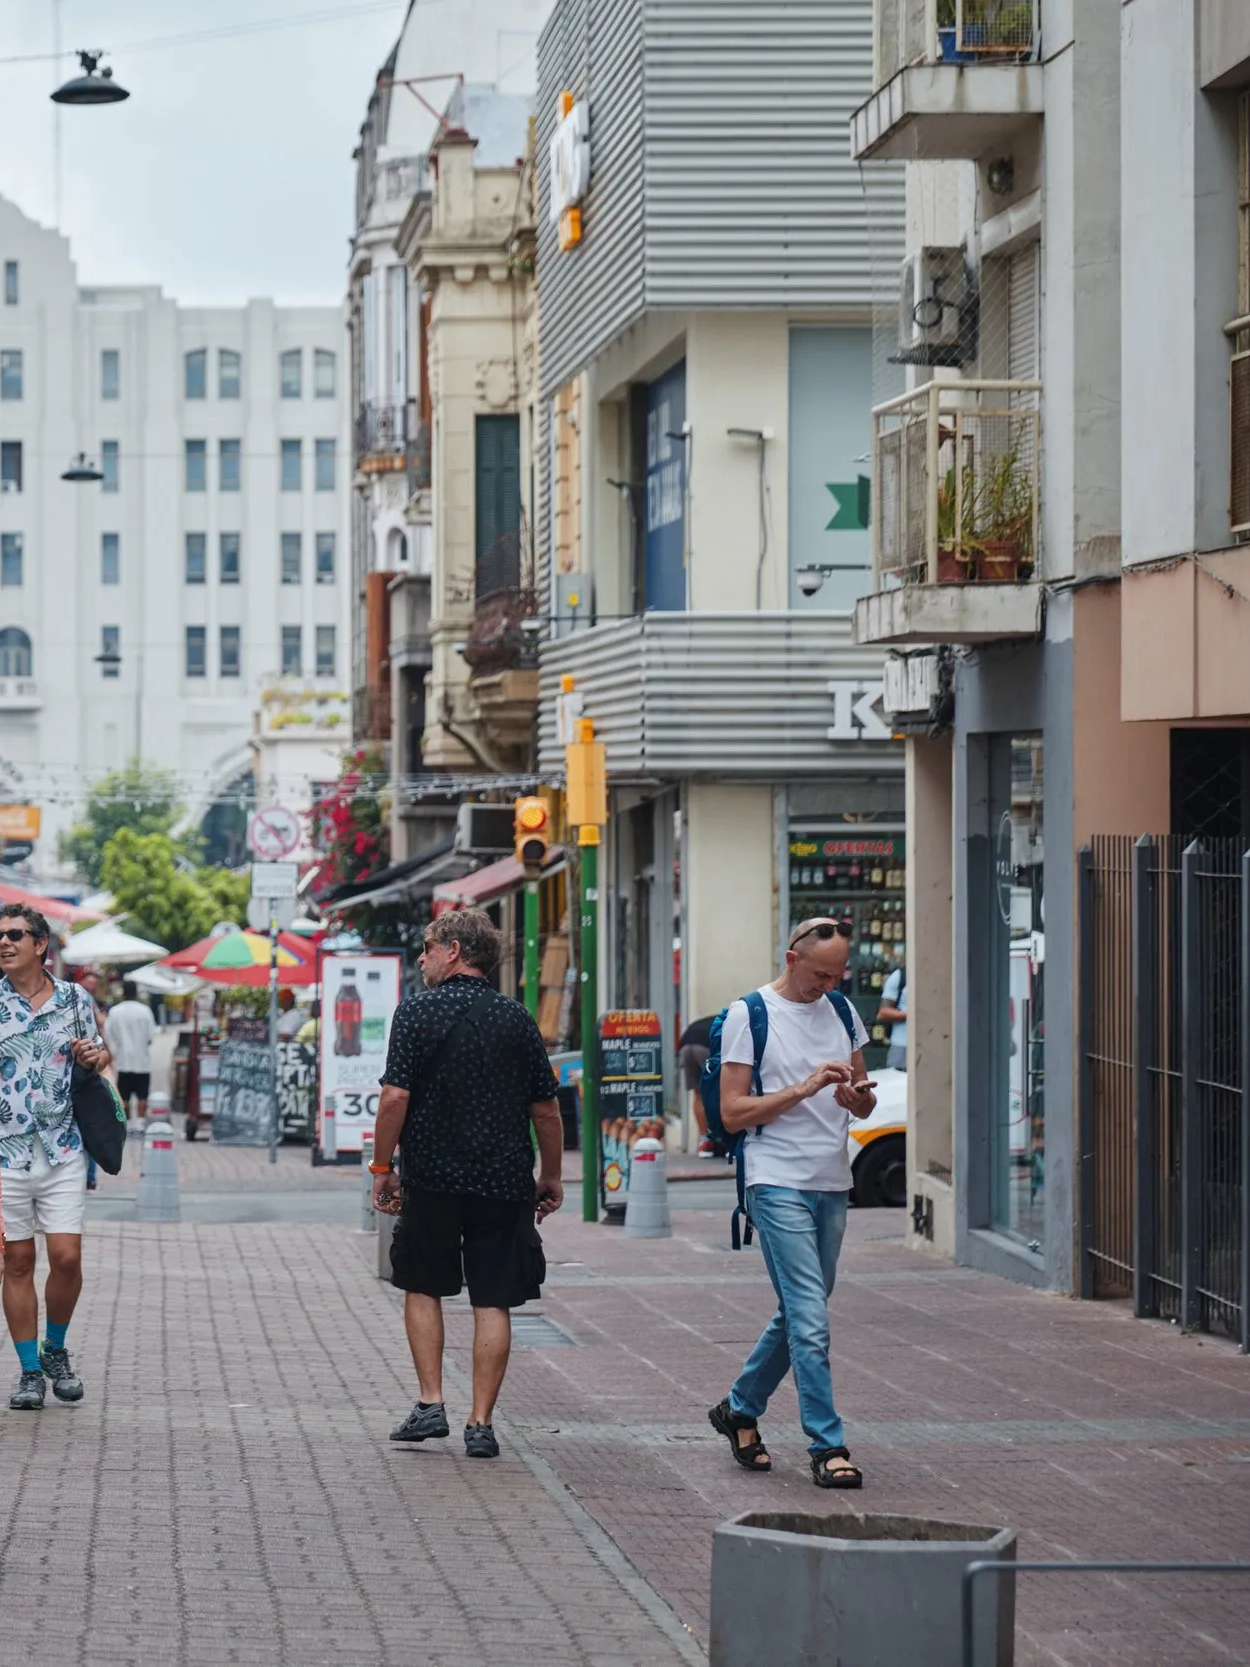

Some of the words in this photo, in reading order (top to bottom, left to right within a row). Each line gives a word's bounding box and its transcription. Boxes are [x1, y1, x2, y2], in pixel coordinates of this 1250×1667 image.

[823, 841, 894, 857] OFERTAS
[608, 1010, 656, 1023] OFERTA
[602, 1039, 630, 1050] MAPLE
[610, 1082, 636, 1094] MAPLE
